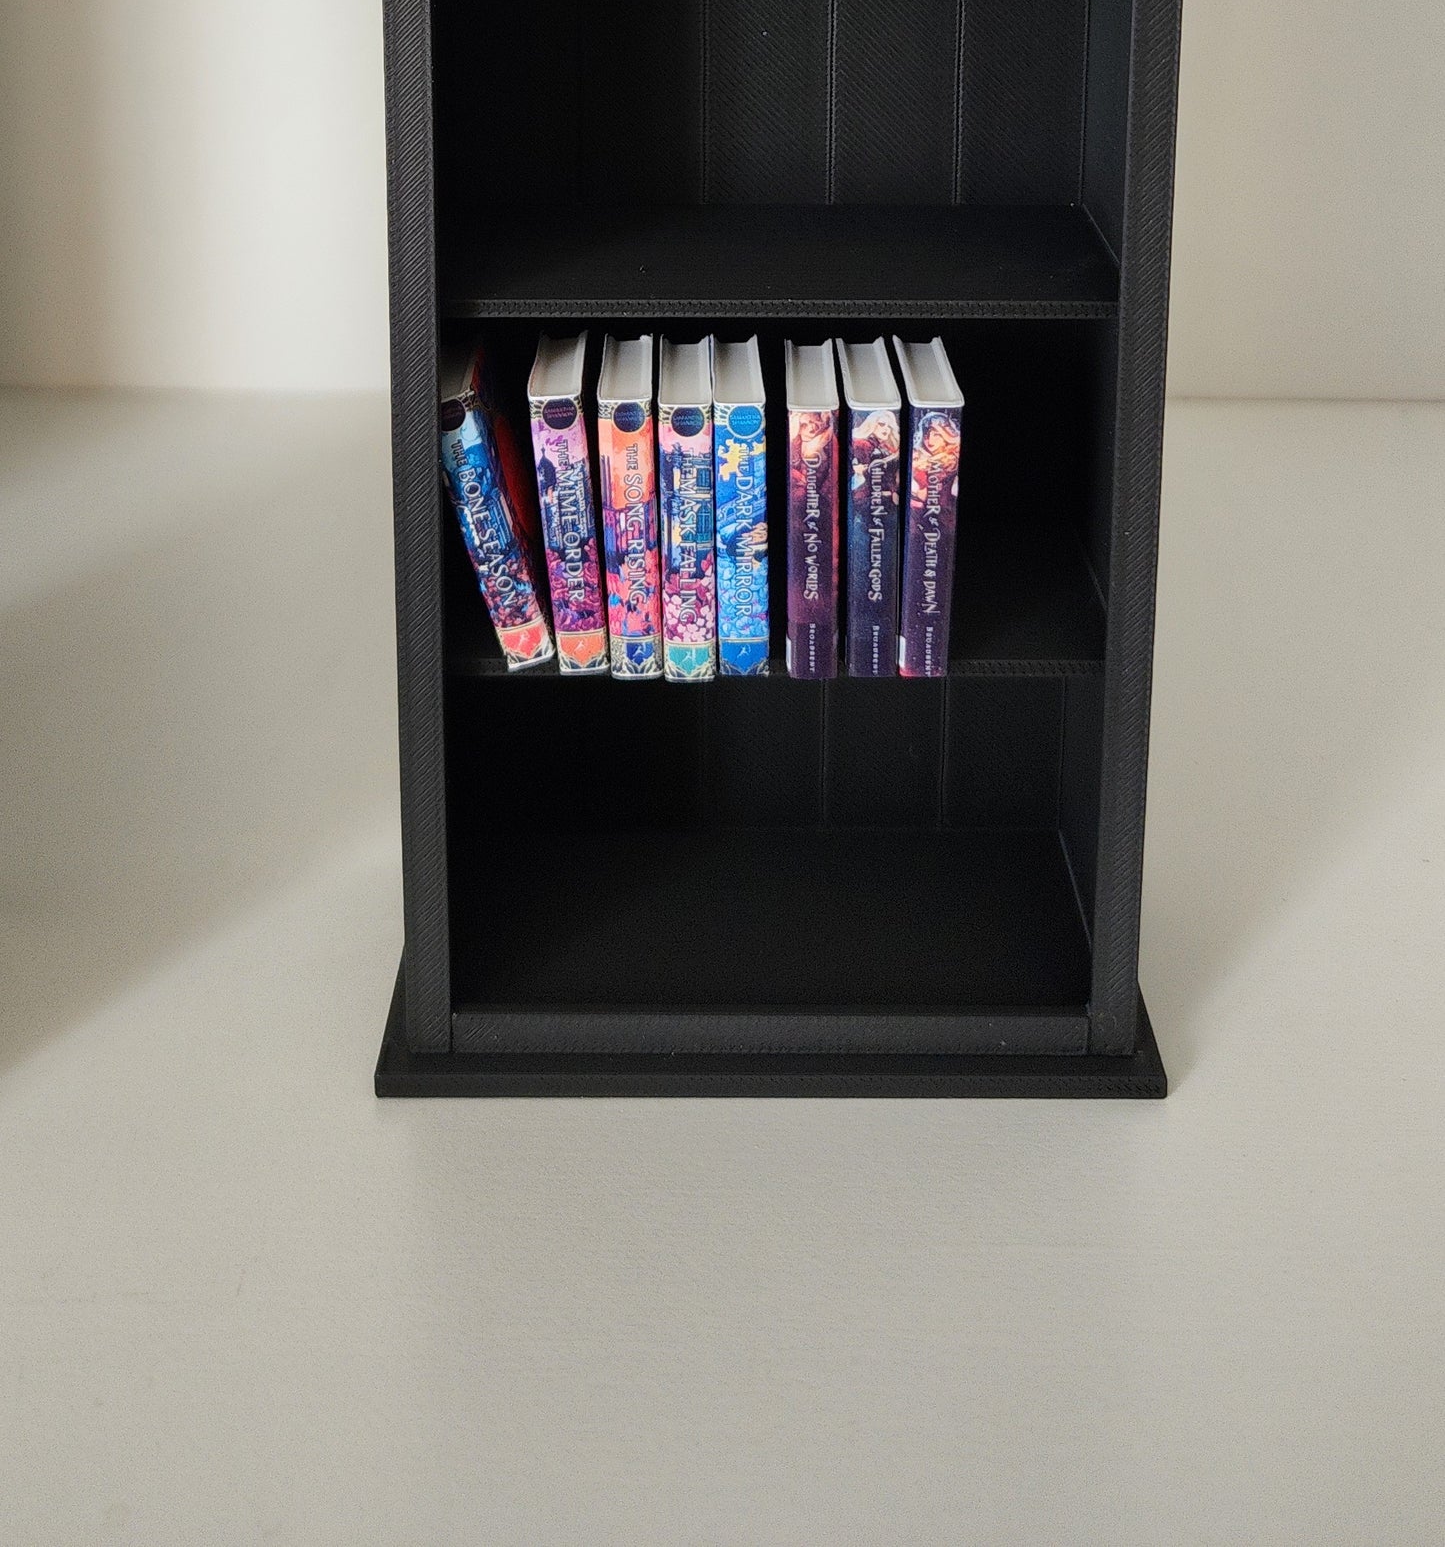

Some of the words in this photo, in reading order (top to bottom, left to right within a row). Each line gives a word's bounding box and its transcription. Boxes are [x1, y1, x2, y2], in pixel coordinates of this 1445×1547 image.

[450, 439, 468, 467] THE
[556, 439, 569, 466] THE
[625, 443, 639, 471] THE
[458, 467, 492, 524] BONE
[557, 468, 580, 526] MIME
[623, 474, 643, 531] SONG
[679, 477, 697, 537] MASK
[735, 475, 753, 532] DARK
[802, 452, 822, 522] DAUGHTER
[868, 460, 888, 516] CHILDREN
[923, 460, 942, 518] MOTHER
[478, 527, 518, 606] SEASON
[563, 531, 585, 602] ORDER
[803, 532, 822, 553] NO
[868, 528, 885, 568] FALLEN
[923, 527, 941, 567] DEATH
[627, 538, 647, 605] RISING
[679, 541, 697, 623] FALLING
[735, 536, 753, 617] MIRROR
[803, 554, 820, 601] WORLDS
[868, 568, 883, 602] GODS
[922, 580, 941, 614] DAWN
[808, 622, 816, 673] BROADBENT
